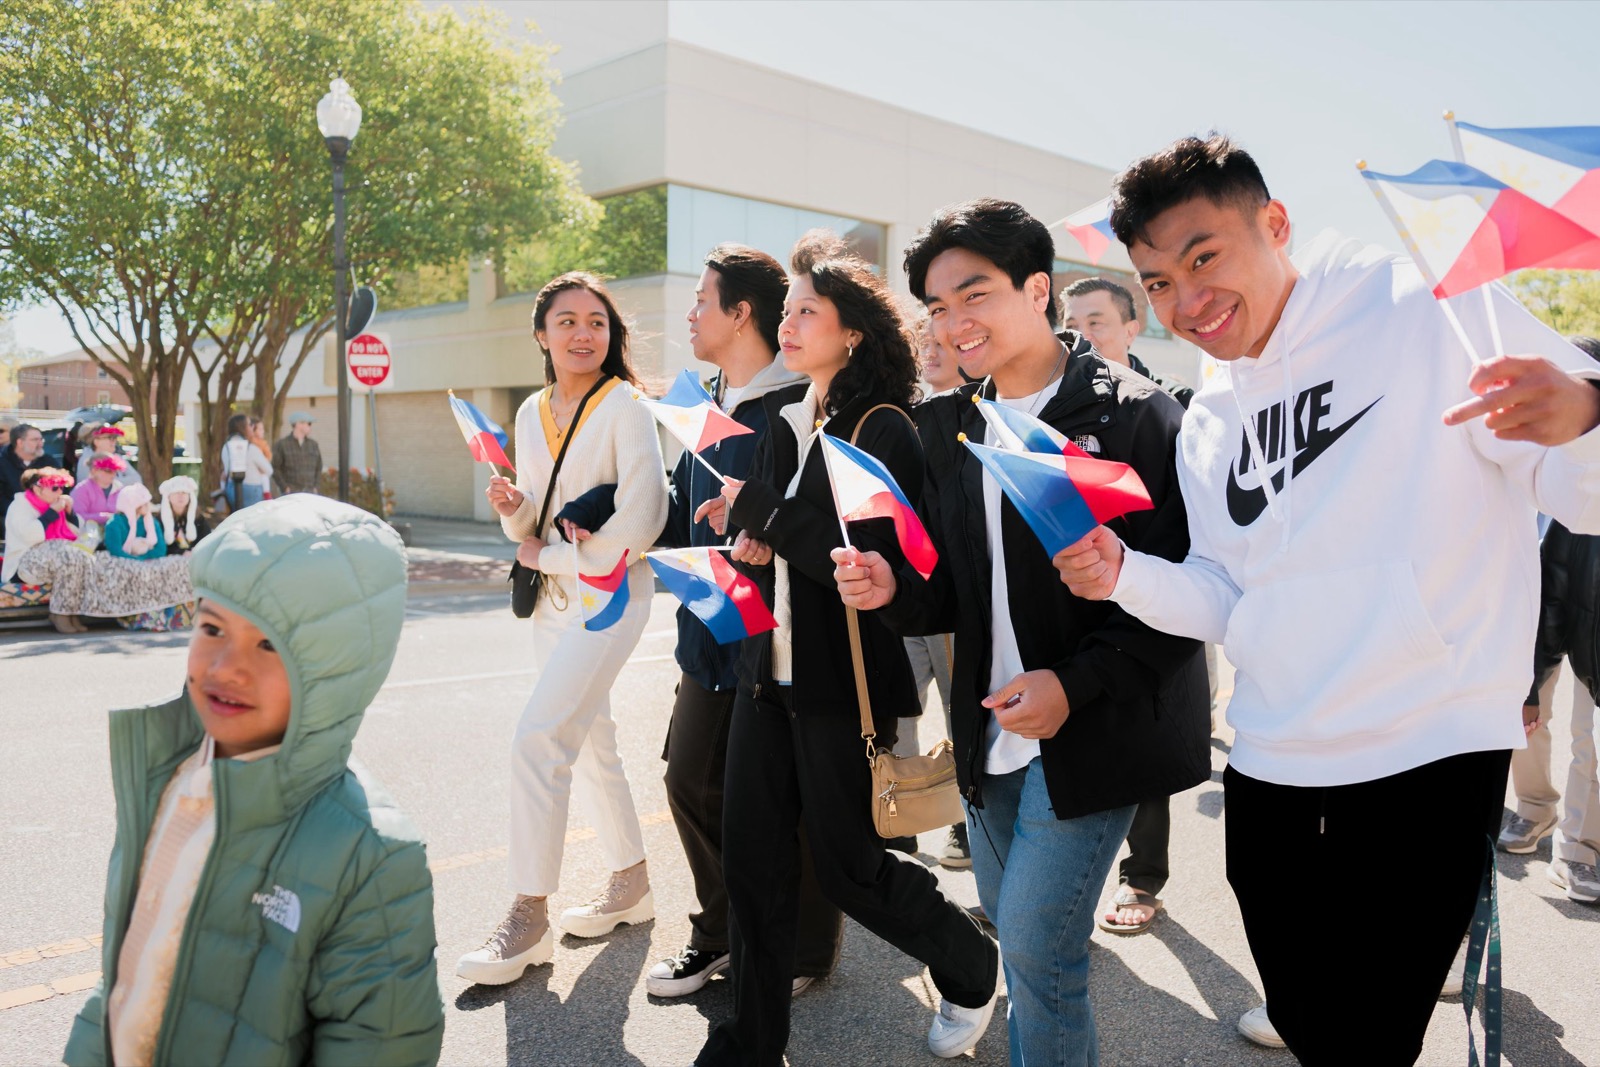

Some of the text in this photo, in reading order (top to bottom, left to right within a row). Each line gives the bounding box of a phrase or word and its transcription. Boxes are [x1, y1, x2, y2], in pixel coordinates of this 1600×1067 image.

[352, 342, 384, 354] DO NOT
[356, 366, 384, 378] ENTER
[1238, 379, 1334, 477] NIKE
[252, 890, 290, 913] NORTH
[272, 884, 292, 904] THE
[262, 906, 286, 926] FACE
